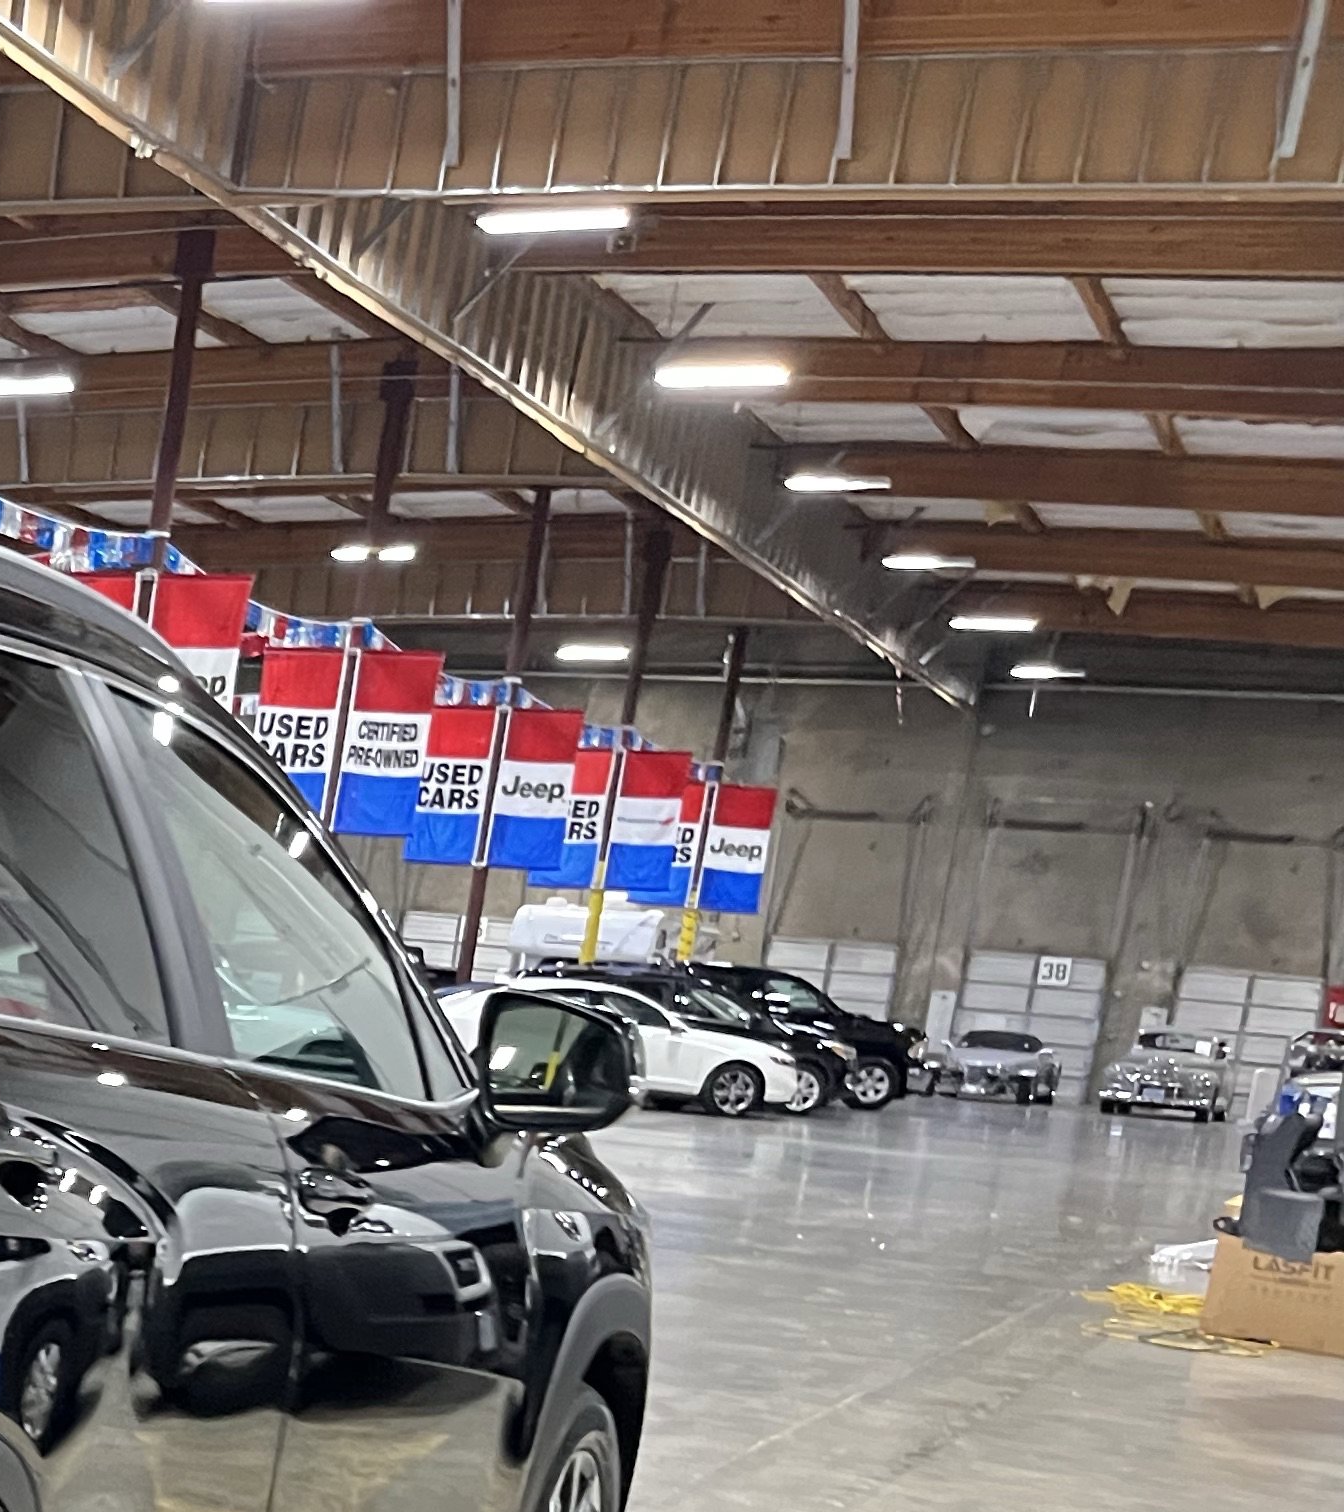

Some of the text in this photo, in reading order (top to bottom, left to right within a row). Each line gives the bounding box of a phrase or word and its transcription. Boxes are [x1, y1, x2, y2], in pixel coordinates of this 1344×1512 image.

[258, 712, 330, 741] USED
[358, 720, 418, 742] CERTIFIED
[346, 745, 419, 768] PRE-OWNED
[421, 761, 484, 786] USED
[417, 785, 480, 810] CARS
[501, 775, 566, 804] Jeep
[569, 800, 600, 819] ED
[567, 821, 598, 841] RS
[709, 837, 763, 862] Jeep
[1041, 962, 1068, 981] 38
